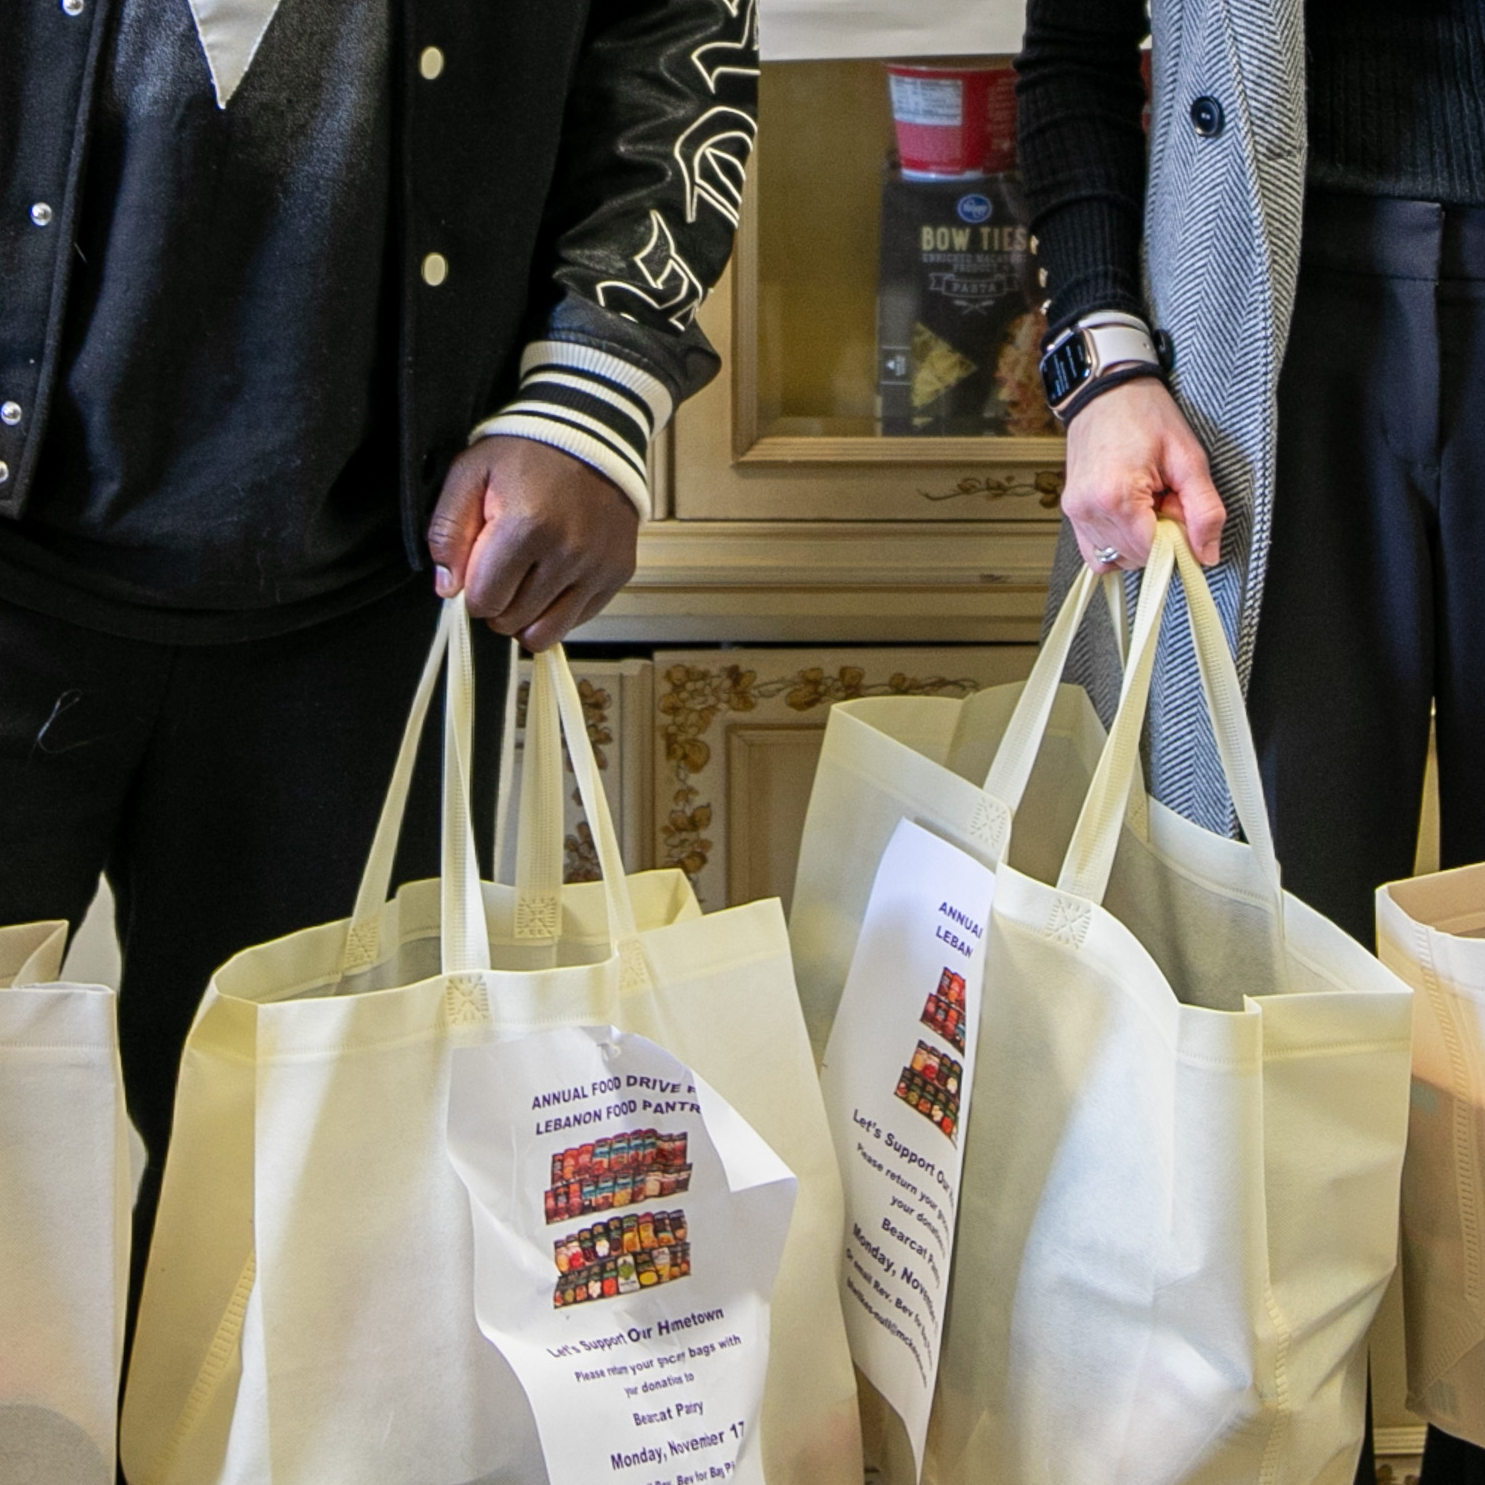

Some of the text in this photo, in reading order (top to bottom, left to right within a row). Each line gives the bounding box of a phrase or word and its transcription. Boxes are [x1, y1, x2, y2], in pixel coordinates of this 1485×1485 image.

[921, 226, 1027, 252] BOW TIES
[531, 1075, 681, 1110] ANNUAL FOOD DRIVE
[536, 1100, 701, 1135] LEBANON FOOD PANTR
[853, 1109, 936, 1177] Let's Support
[885, 1169, 918, 1195] return
[890, 1196, 915, 1216] your
[881, 1217, 928, 1259] Bearcat
[546, 1333, 626, 1358] Let's Support
[574, 1334, 742, 1383] Please your bags with
[685, 1372, 695, 1382] to
[610, 1446, 668, 1470] Monday,
